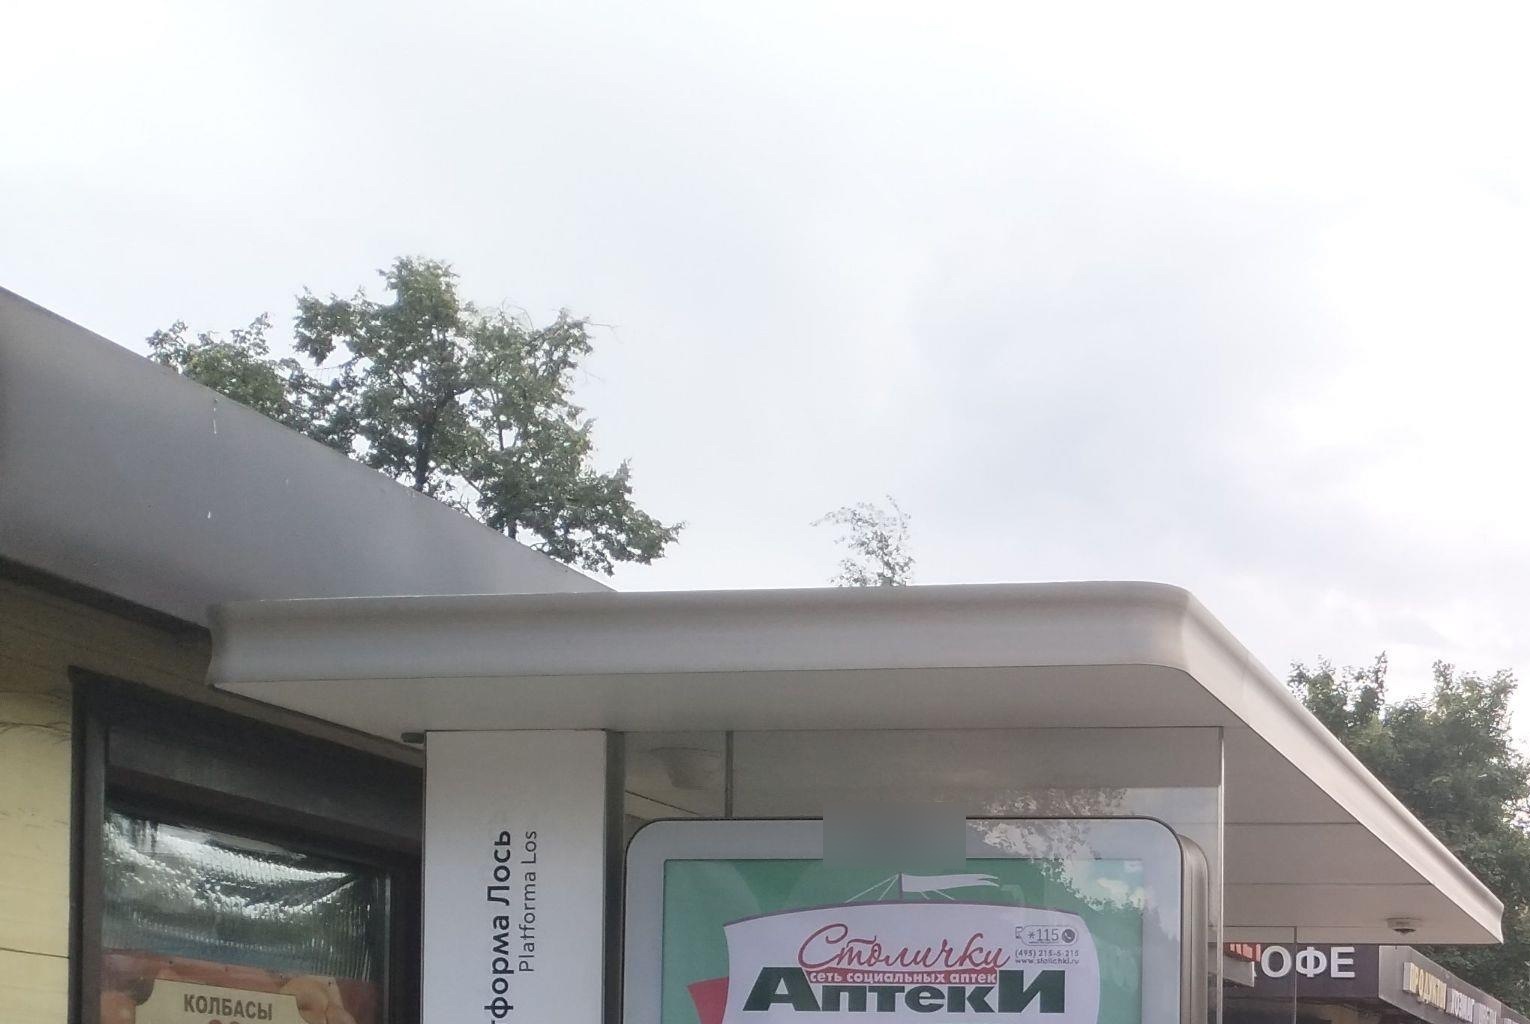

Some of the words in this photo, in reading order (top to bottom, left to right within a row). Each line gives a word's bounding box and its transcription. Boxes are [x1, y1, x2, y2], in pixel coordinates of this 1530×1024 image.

[488, 830, 512, 906] Лось
[520, 830, 537, 868] Los
[518, 871, 538, 972] Platforma
[798, 923, 1010, 970] Столички
[1253, 945, 1356, 978] ОФЕ
[810, 971, 842, 984] сеть
[846, 970, 945, 985] социальных
[950, 972, 997, 985] аптек
[183, 993, 273, 1021] КОЛБАСЫ
